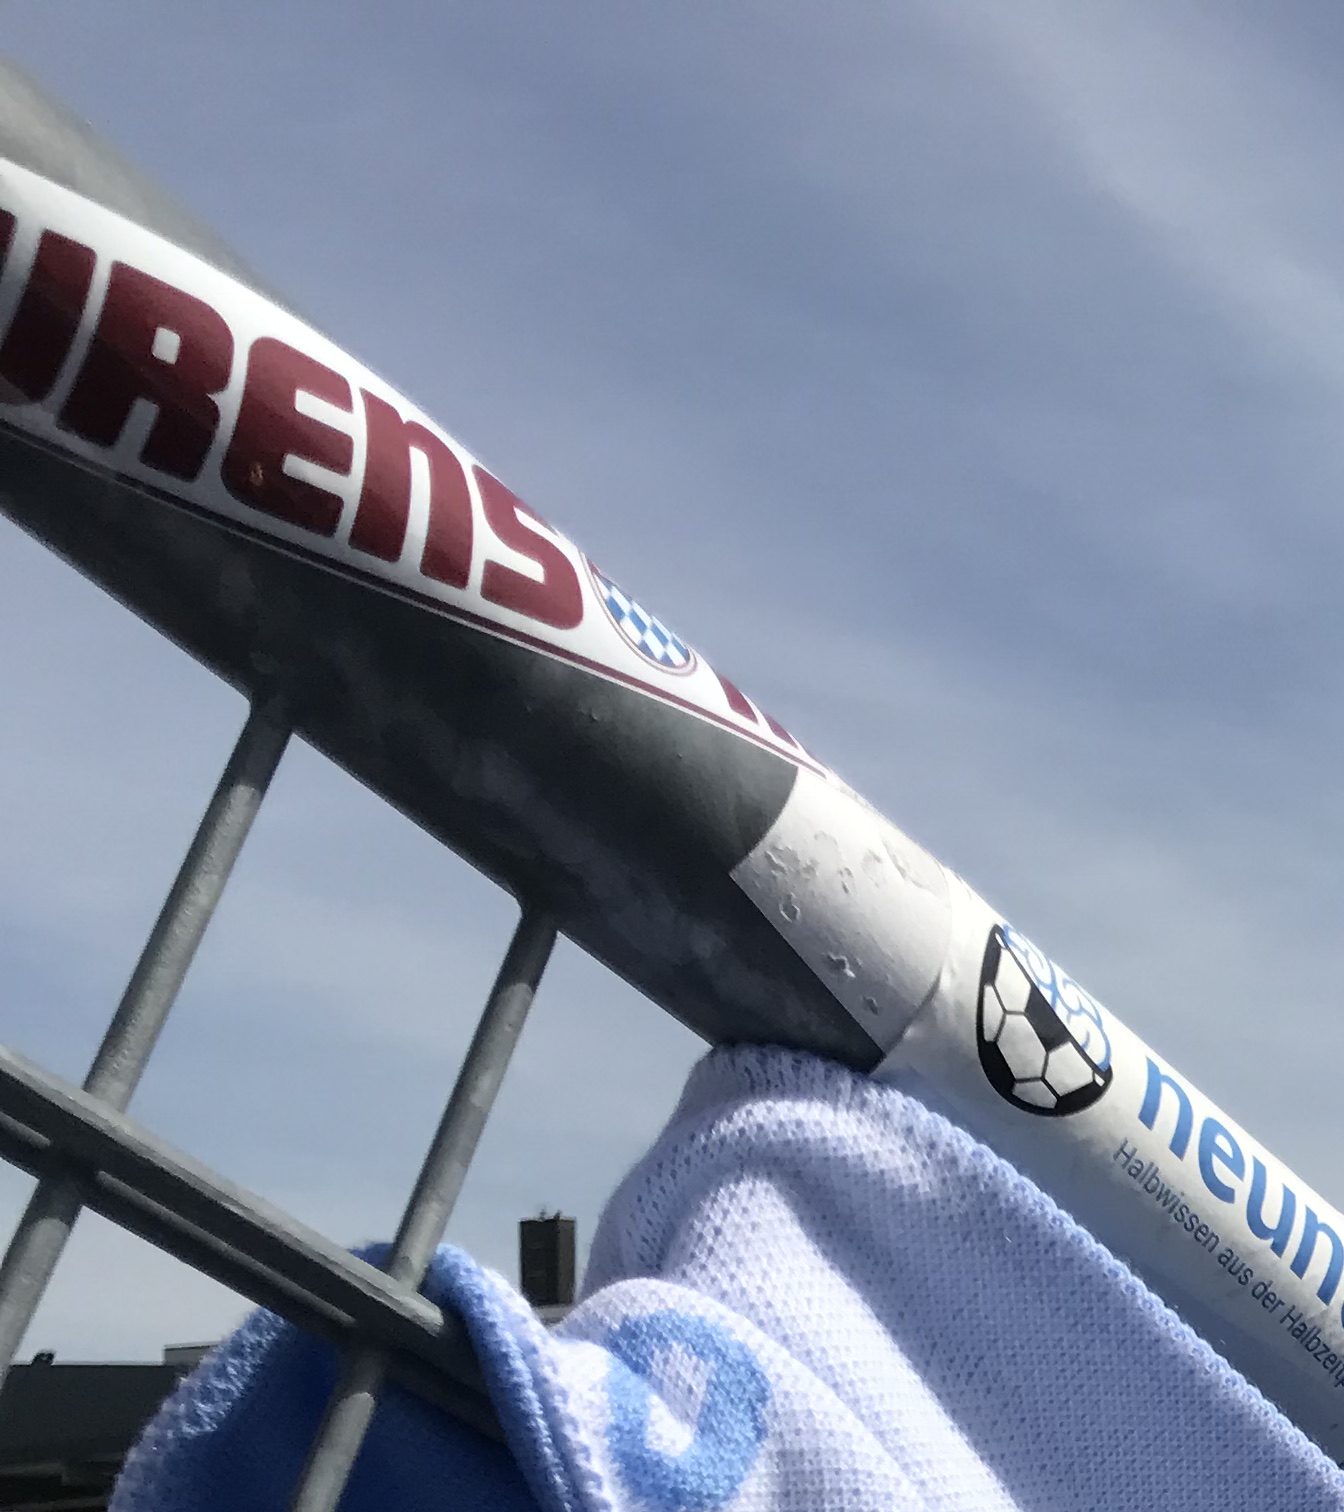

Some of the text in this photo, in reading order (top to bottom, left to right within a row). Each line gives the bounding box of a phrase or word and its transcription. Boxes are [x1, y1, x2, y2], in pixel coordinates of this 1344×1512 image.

[1111, 1139, 1219, 1256] Halbwissen
[1217, 1245, 1255, 1286] aus
[1250, 1278, 1285, 1318] der
